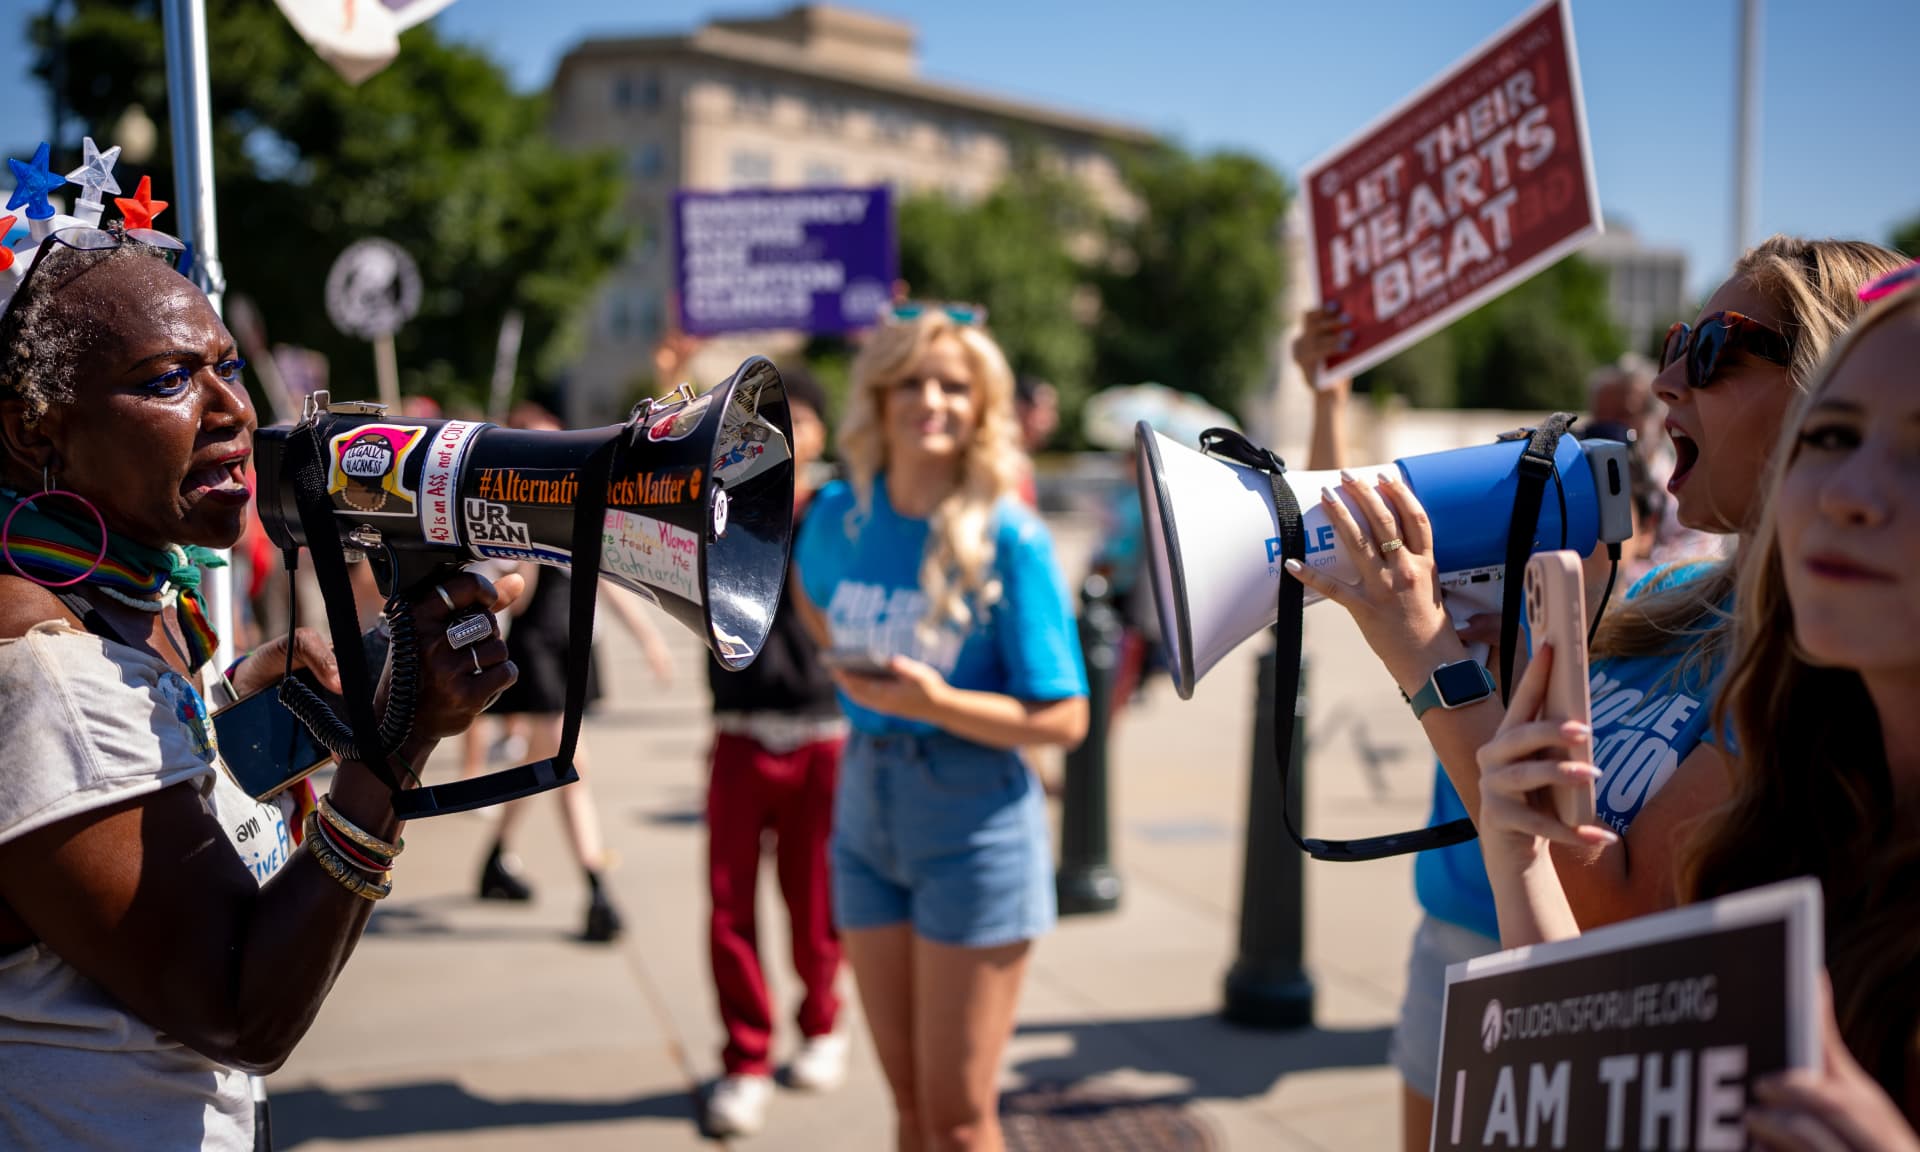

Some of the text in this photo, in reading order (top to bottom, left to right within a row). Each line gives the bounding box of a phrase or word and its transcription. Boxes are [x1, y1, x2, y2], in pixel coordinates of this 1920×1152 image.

[1336, 155, 1405, 229] LET
[1416, 69, 1537, 175] THEIR
[1330, 105, 1557, 288] HEARTS
[1373, 188, 1519, 322] BEAT
[438, 450, 452, 468] not
[434, 501, 446, 514] an
[434, 516, 447, 525] is
[466, 500, 506, 526] UR
[604, 510, 624, 529] ell
[430, 528, 449, 541] 45
[469, 522, 527, 544] BAN
[1264, 525, 1335, 563] PLE
[1502, 974, 1718, 1040] STUDENTSFORLIFE.ORG
[1451, 1045, 1748, 1152] I AM THE
